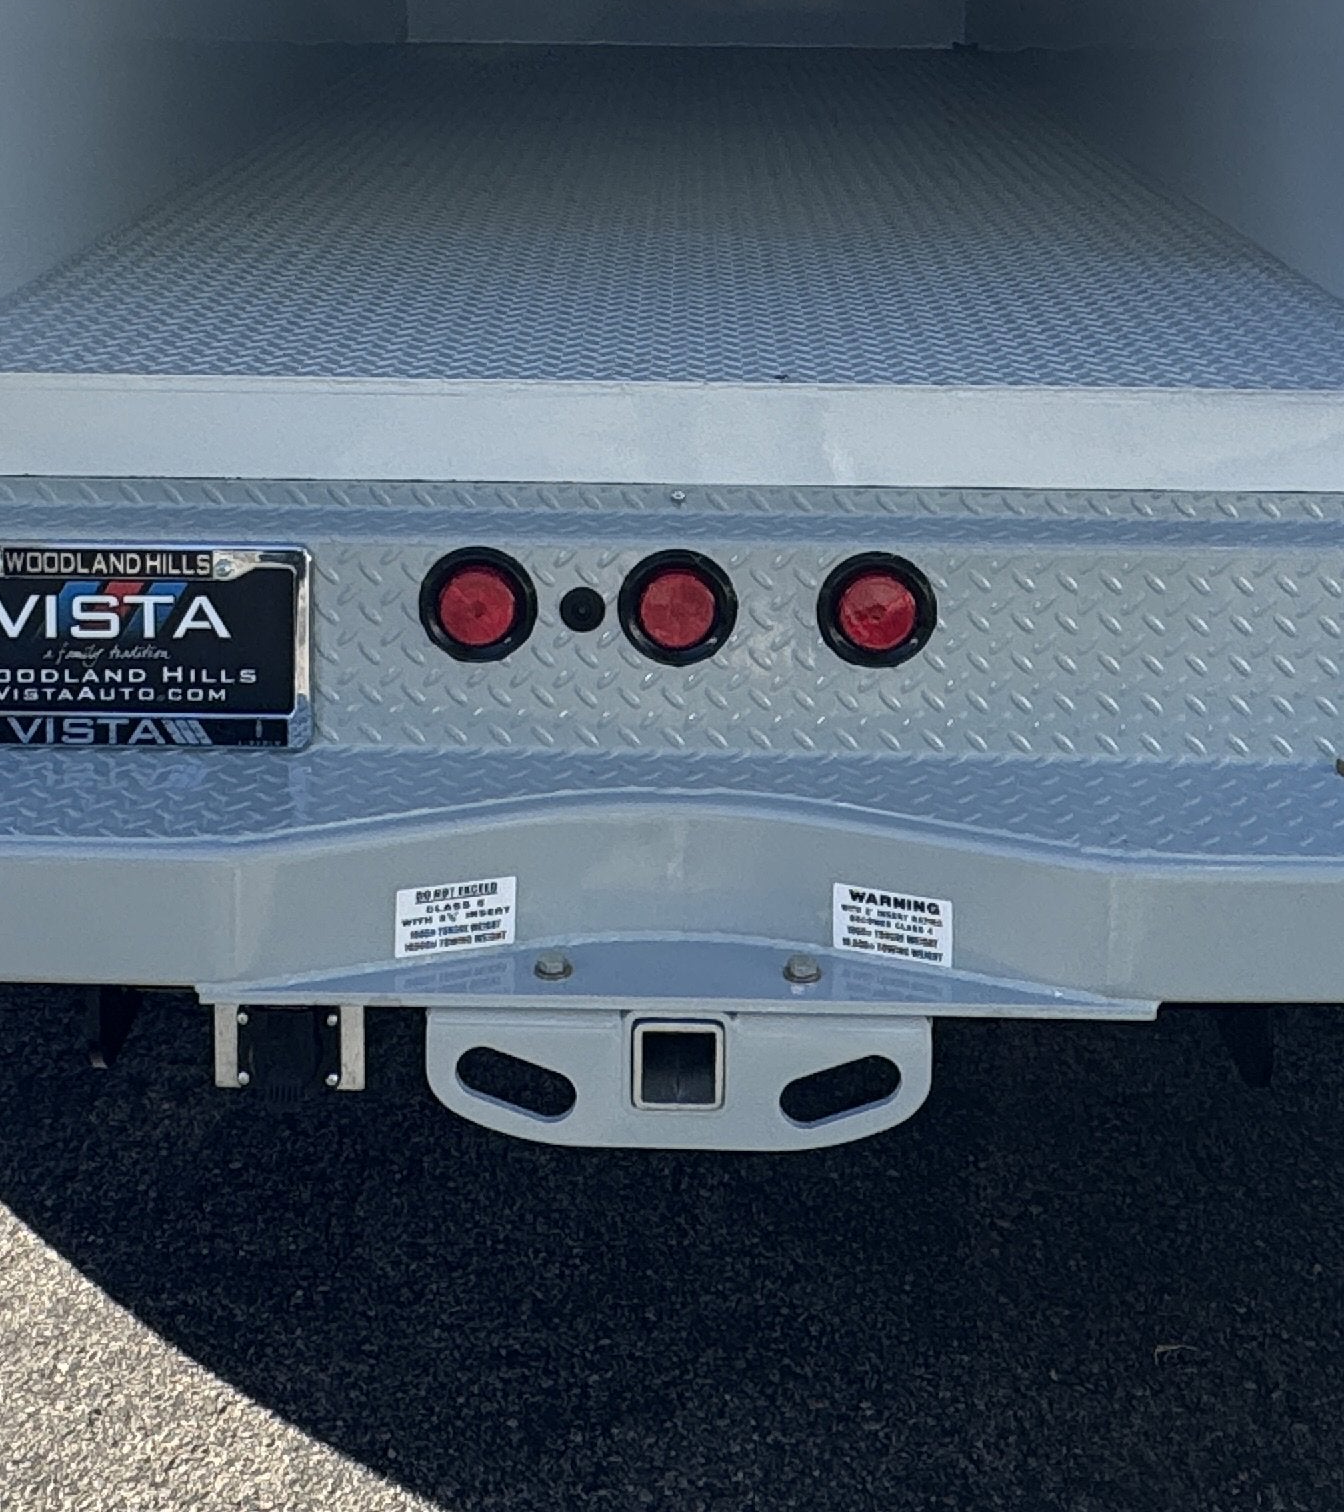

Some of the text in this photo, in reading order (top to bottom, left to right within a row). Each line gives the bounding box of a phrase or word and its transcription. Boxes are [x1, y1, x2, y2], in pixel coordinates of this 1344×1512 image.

[6, 551, 211, 576] WOODLAND HILLS
[162, 666, 257, 684] HILLS
[7, 716, 168, 744] VISTA
[849, 889, 940, 915] WARNING
